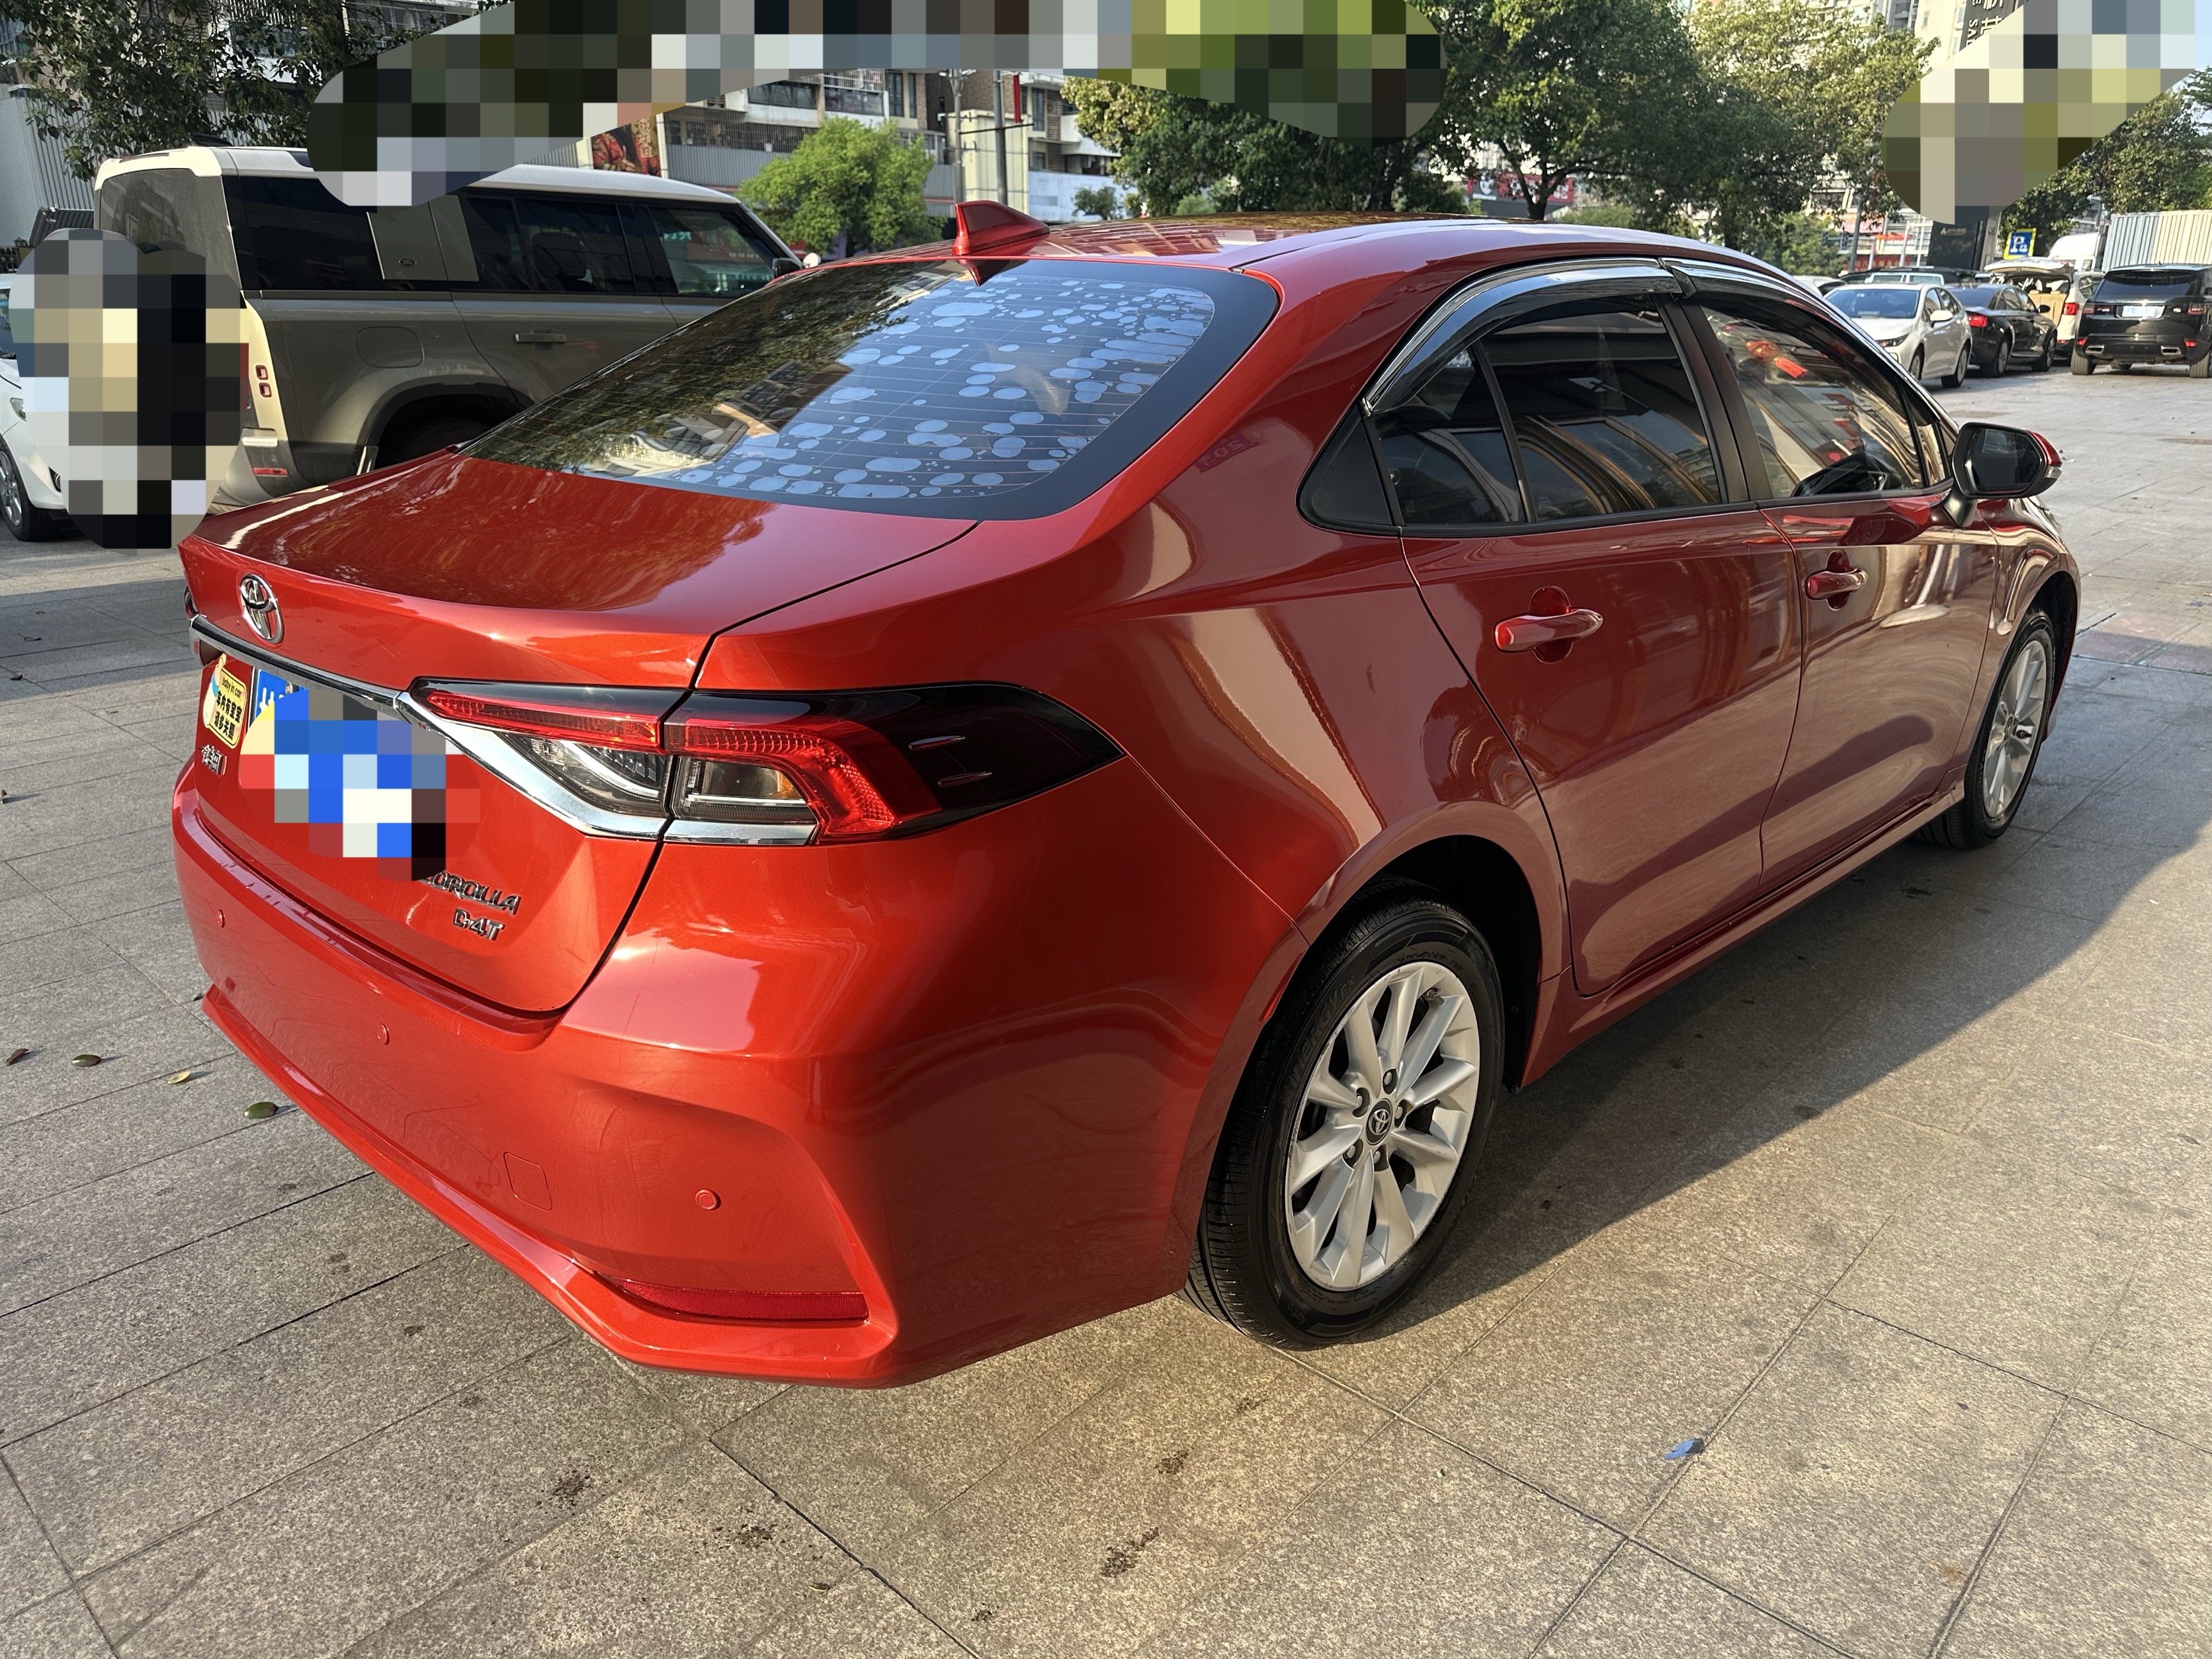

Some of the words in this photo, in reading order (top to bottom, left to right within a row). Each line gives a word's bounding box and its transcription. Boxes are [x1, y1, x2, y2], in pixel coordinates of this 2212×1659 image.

[222, 675, 230, 693] baby
[216, 690, 243, 724] 车内有宝宝
[419, 871, 522, 915] OROLLA
